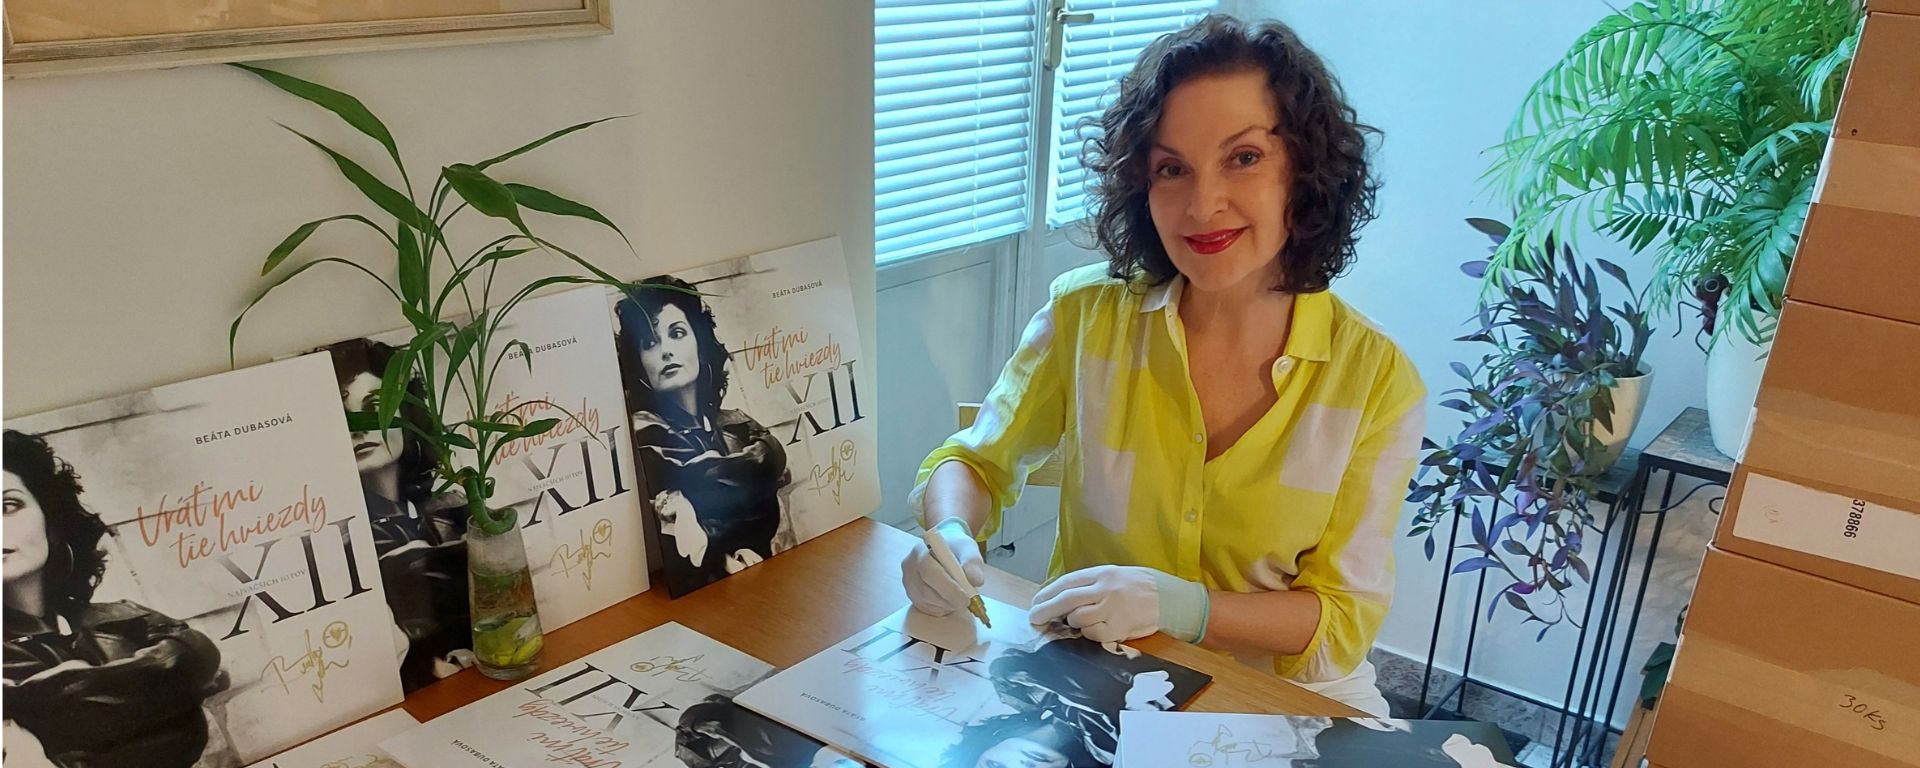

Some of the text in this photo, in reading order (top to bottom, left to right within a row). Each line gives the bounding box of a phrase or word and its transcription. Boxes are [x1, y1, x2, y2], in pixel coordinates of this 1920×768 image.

[772, 279, 823, 299] BEÁTA DUBASOVÁ
[508, 336, 578, 360] BEÁA DUBASOVÁ
[760, 333, 841, 389] tie hviezdy
[781, 327, 808, 354] mi
[195, 413, 294, 445] BEÁTA DUBASOVÁ
[784, 360, 866, 446] XII
[521, 425, 631, 529] XII
[136, 480, 264, 547] Vráť mi
[169, 484, 327, 569] tie hviezdy
[1843, 498, 1867, 539] 378866
[217, 515, 373, 641] XII
[524, 662, 680, 732] XII
